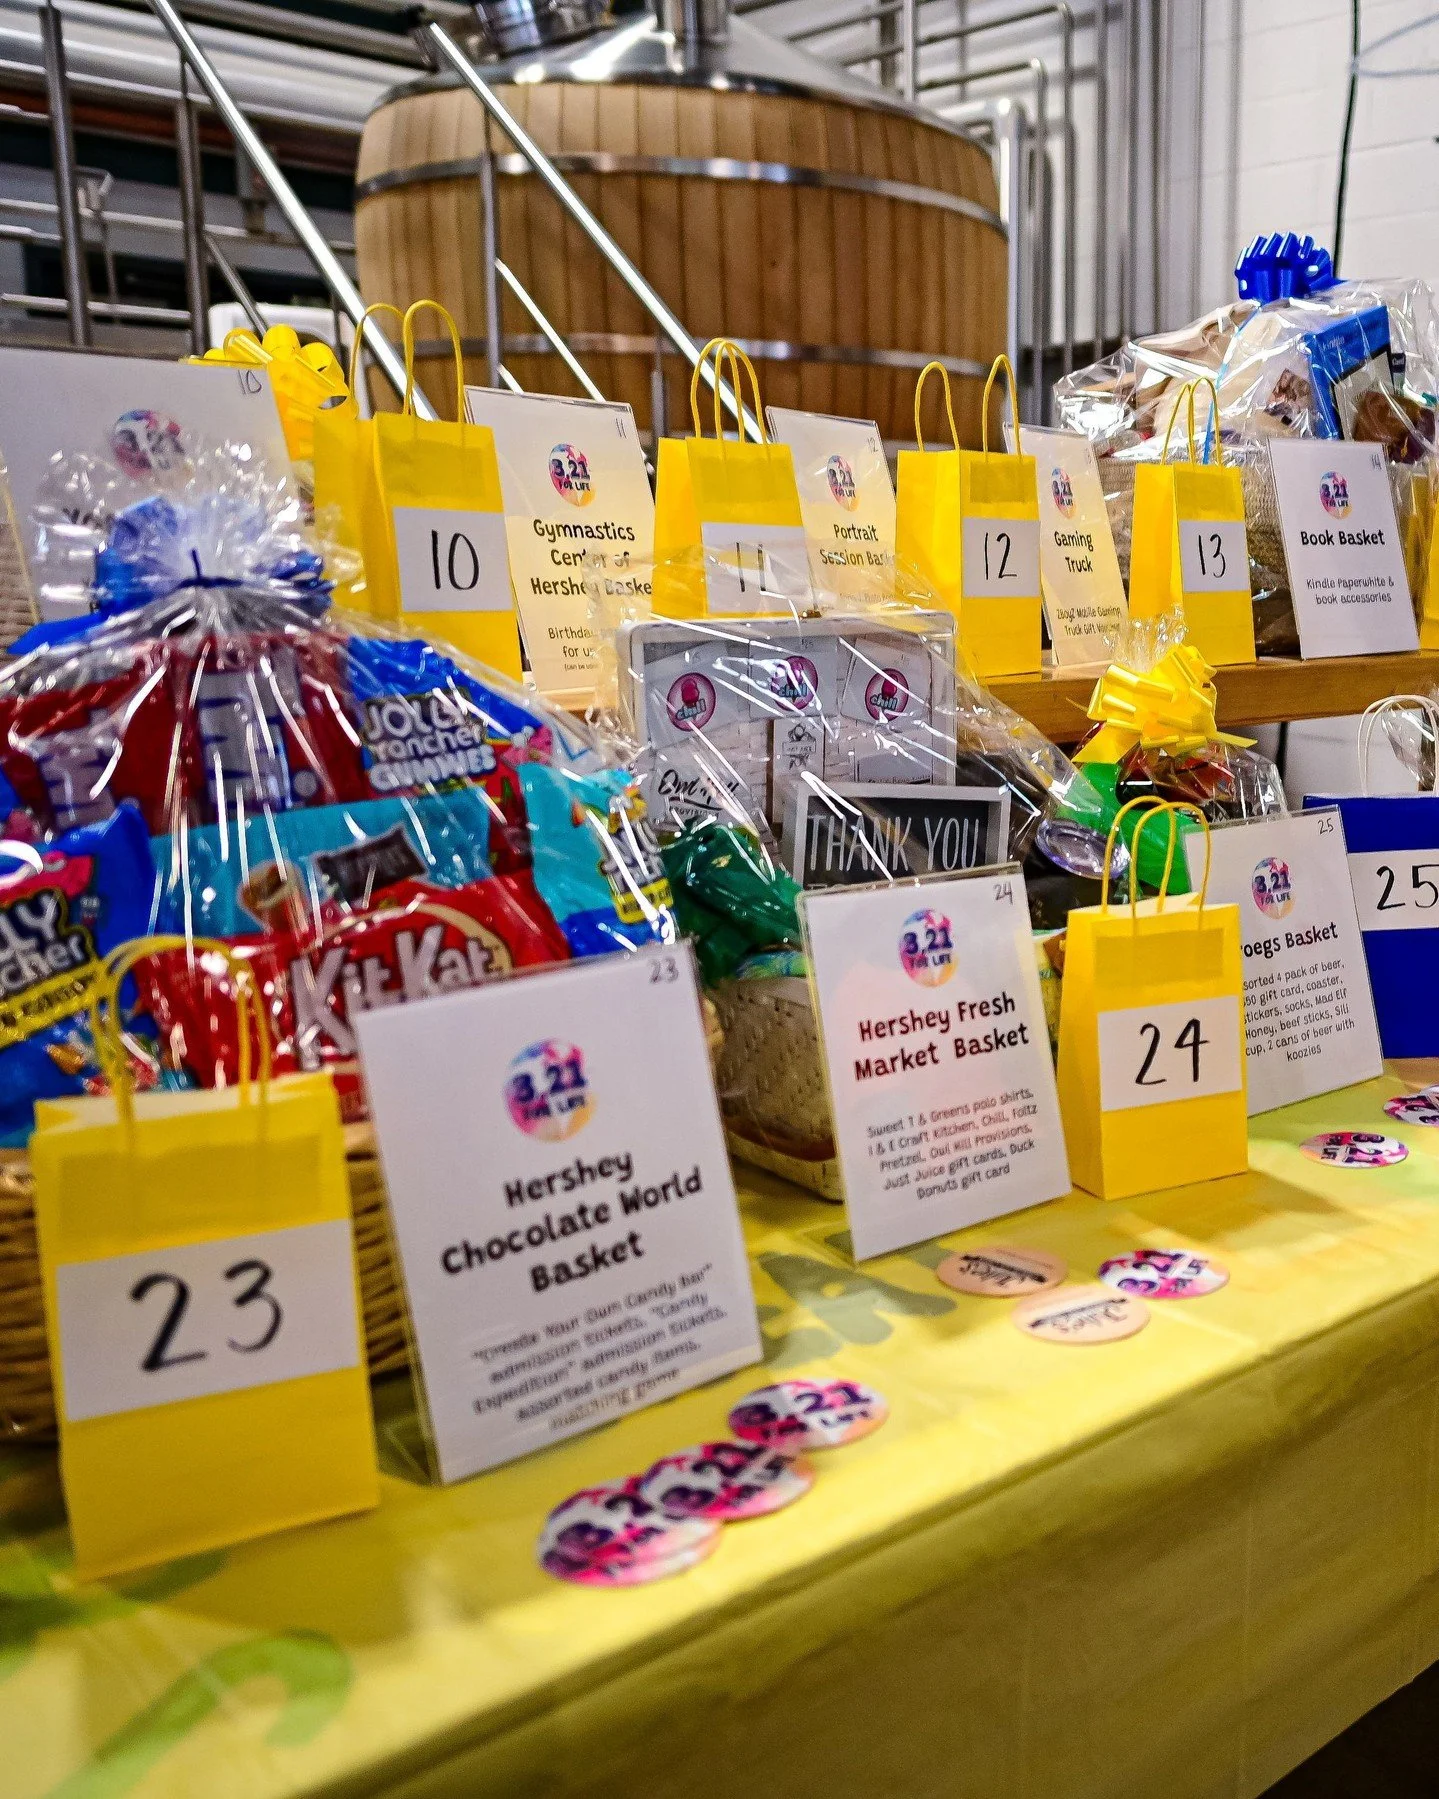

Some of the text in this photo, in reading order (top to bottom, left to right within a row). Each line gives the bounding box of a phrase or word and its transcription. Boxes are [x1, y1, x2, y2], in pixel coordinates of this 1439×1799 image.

[238, 369, 262, 395] 10
[552, 458, 591, 482] 3.21
[558, 478, 591, 491] FOR LIFE
[1321, 483, 1349, 500] 3.21
[533, 518, 636, 543] Gymnastics
[834, 523, 879, 542] Portrait
[1054, 530, 1094, 552] Gaming
[1300, 529, 1385, 546] Book Basket
[431, 529, 481, 592] 10
[819, 548, 864, 566] Session
[984, 531, 1018, 582] 12
[1065, 555, 1093, 573] Truck
[1197, 533, 1228, 580] 13
[604, 577, 652, 597] Baske
[1306, 578, 1336, 590] Kindle
[1338, 576, 1386, 591] Paperwhite
[1315, 592, 1392, 605] book accessories
[548, 626, 596, 640] Birthda
[1064, 623, 1082, 636] Truck
[1083, 622, 1095, 635] Gift
[562, 645, 579, 658] for
[870, 693, 898, 711] chill
[1318, 817, 1334, 836] 25
[807, 814, 980, 872] THANK YOU
[993, 881, 1013, 905] 24
[1254, 870, 1291, 893] 3.21
[1375, 863, 1439, 911] 25
[1261, 892, 1291, 906] FOR LIFE
[903, 926, 953, 956] 3.21
[1285, 921, 1339, 949] Basket
[393, 923, 491, 1000] Kat
[648, 956, 680, 986] 23
[1285, 965, 1308, 983] pack
[1309, 963, 1319, 975] of
[1321, 958, 1345, 972] beer,
[1260, 989, 1279, 1007] gift
[1315, 993, 1334, 1006] Mad
[1335, 987, 1348, 1001] Elf
[859, 990, 1016, 1042] Hershey Fresh
[1280, 1017, 1301, 1032] beef
[1268, 1039, 1274, 1051] 2
[1276, 1034, 1299, 1049] cans
[1301, 1029, 1311, 1042] of
[1313, 1023, 1333, 1039] beer
[1335, 1017, 1355, 1032] with
[855, 1022, 1030, 1081] Market Basket
[1134, 1017, 1209, 1087] 24
[1286, 1043, 1322, 1062] koozies
[512, 1059, 588, 1105] 3.21
[866, 1117, 904, 1139] Sweet
[918, 1112, 927, 1126] &
[930, 1102, 971, 1123] Greens
[972, 1096, 997, 1115] polo
[899, 1131, 929, 1149] Craft
[930, 1144, 950, 1159] Owl
[953, 1137, 972, 1151] Hill
[883, 1173, 911, 1191] Just
[914, 1166, 946, 1182] Juice
[947, 1156, 970, 1176] gift
[1010, 1138, 1036, 1155] Duck
[503, 1151, 634, 1208] Hershey
[916, 1162, 1011, 1200] Donuts gift card
[440, 1164, 704, 1276] Chocolate World
[529, 1230, 646, 1293] Basket
[129, 1257, 286, 1374] 23
